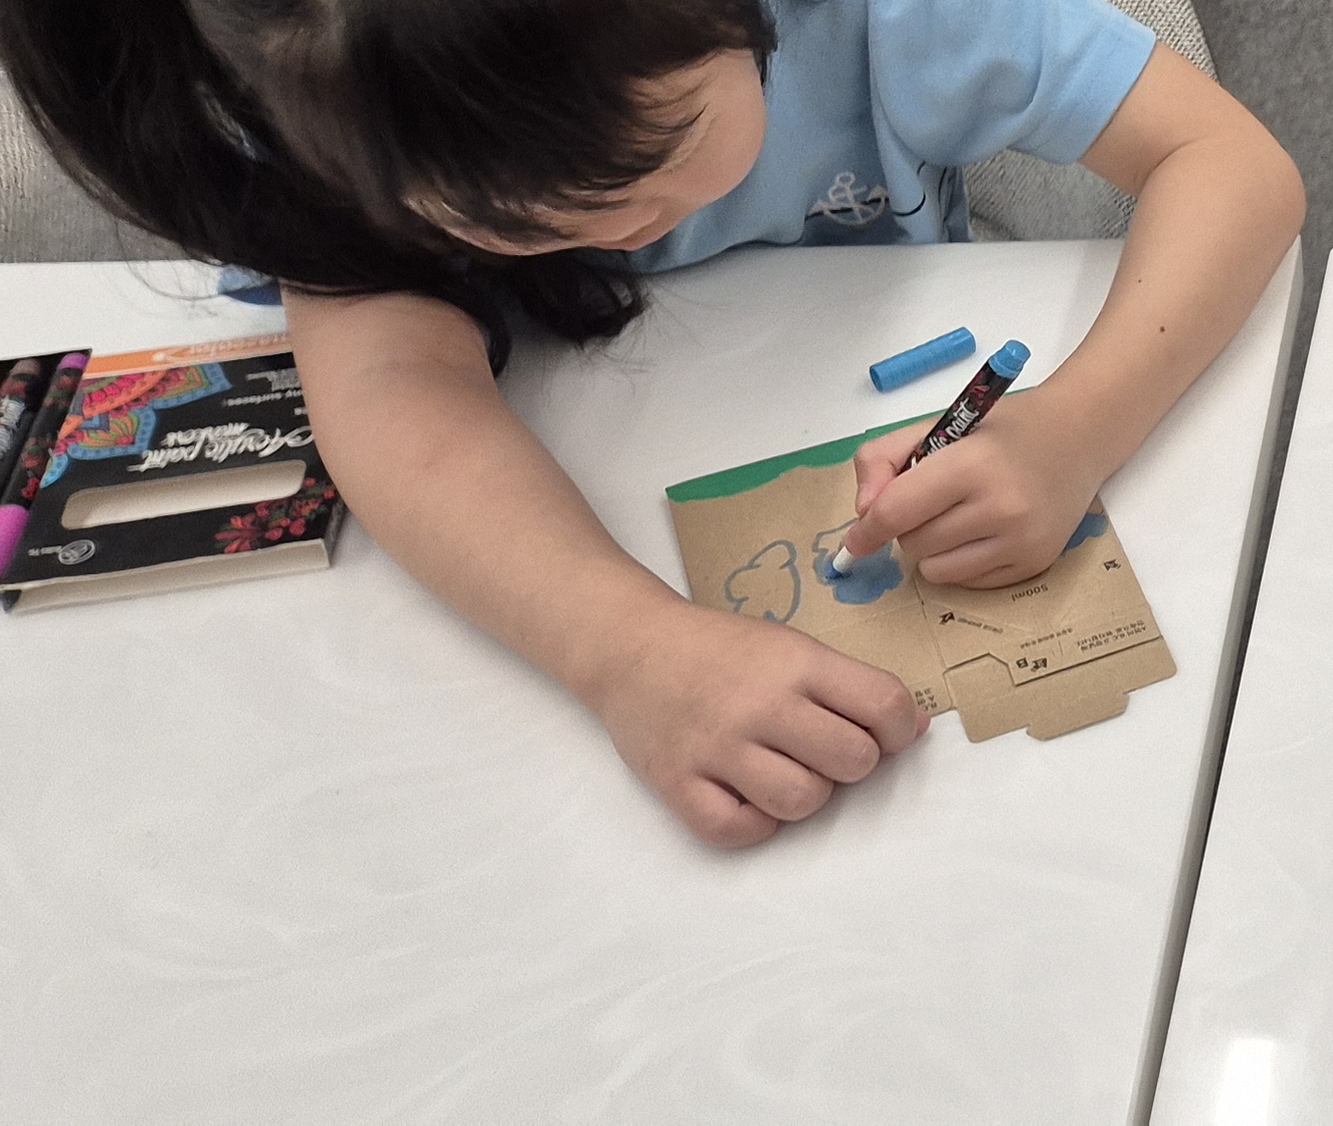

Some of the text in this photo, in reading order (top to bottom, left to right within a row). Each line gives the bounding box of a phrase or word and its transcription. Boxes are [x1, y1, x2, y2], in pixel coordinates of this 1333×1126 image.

[161, 422, 249, 448] markers
[127, 425, 315, 473] Acrylic paint
[1011, 583, 1048, 601] 500ml
[1016, 657, 1029, 669] B
